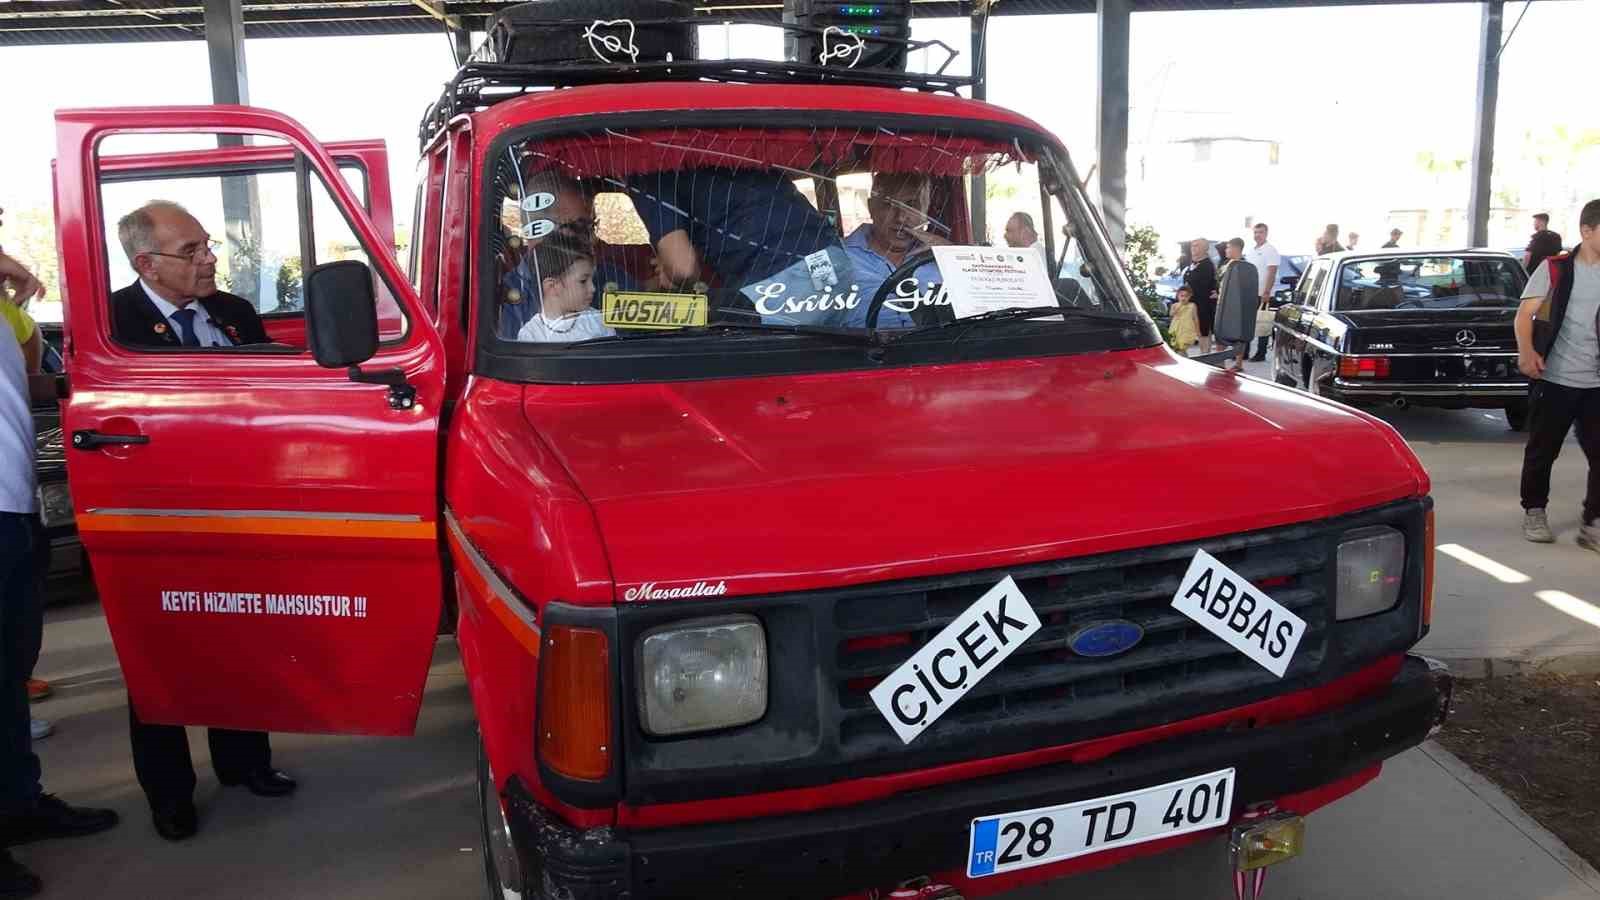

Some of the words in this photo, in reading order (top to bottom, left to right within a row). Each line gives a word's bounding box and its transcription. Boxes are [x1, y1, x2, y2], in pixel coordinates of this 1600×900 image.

[532, 222, 543, 236] E
[882, 278, 953, 312] Gib
[624, 580, 728, 602] Masaallah
[266, 594, 351, 617] MAHSUSTUR
[354, 597, 367, 618] !!!
[1184, 567, 1294, 659] ABBAS
[891, 594, 1029, 726] ÇİÇEK
[998, 816, 1055, 865] 28
[1082, 801, 1137, 847] TD
[1162, 778, 1228, 828] 401
[975, 851, 994, 866] TR
